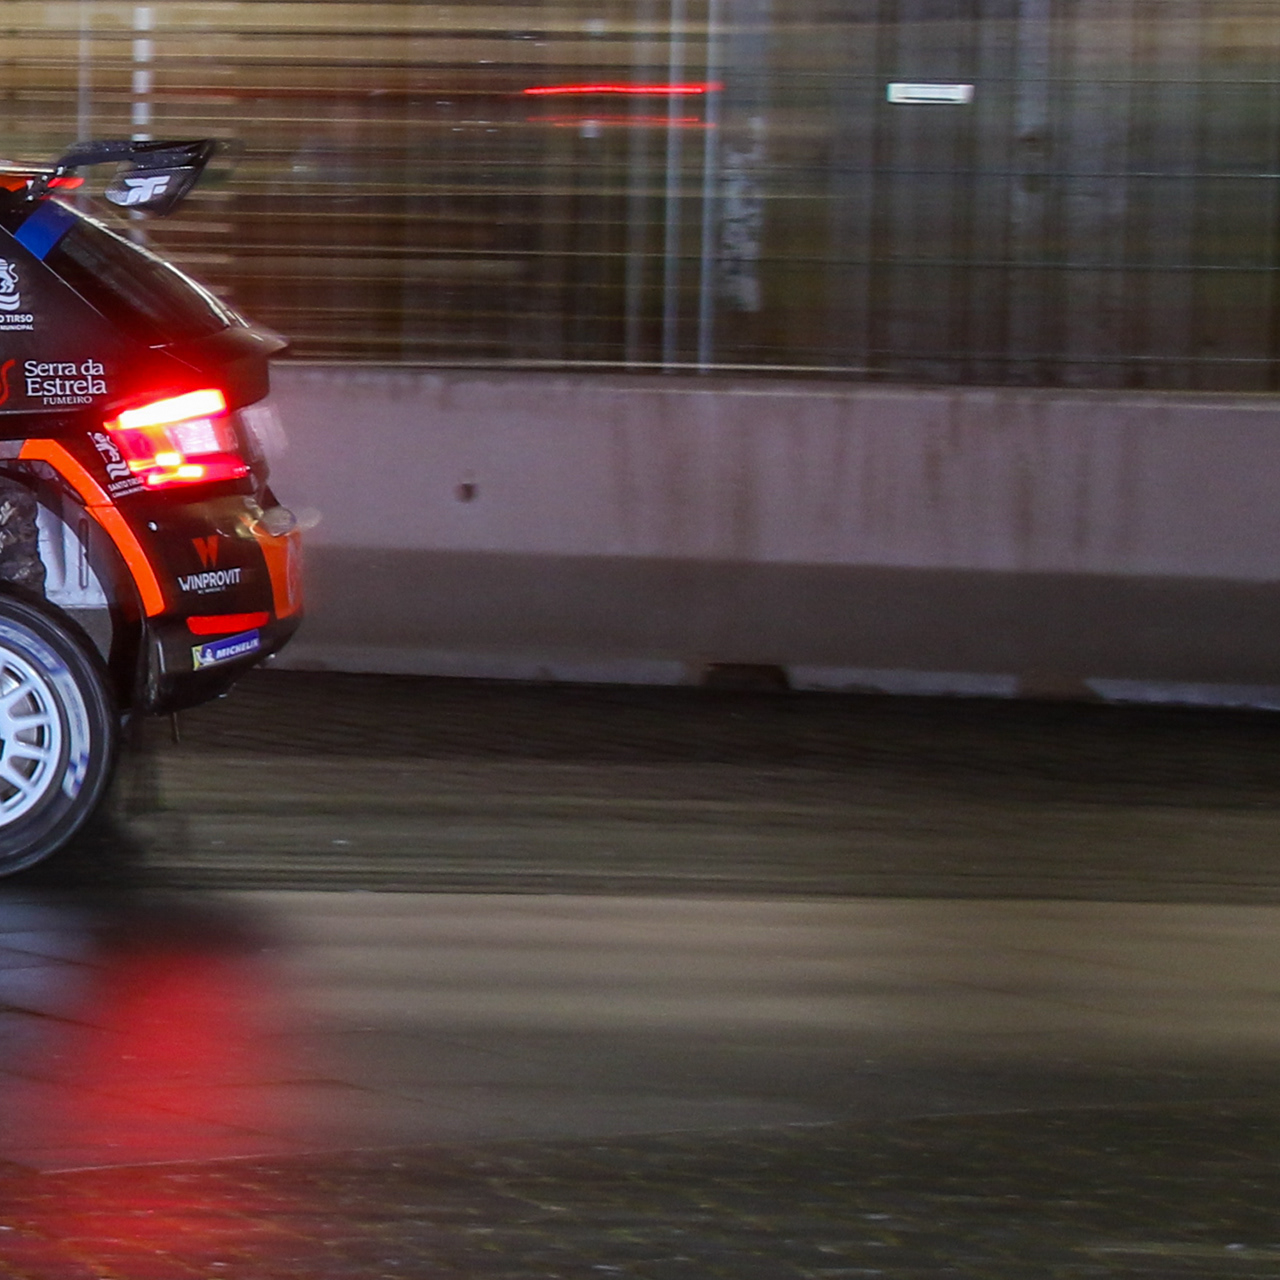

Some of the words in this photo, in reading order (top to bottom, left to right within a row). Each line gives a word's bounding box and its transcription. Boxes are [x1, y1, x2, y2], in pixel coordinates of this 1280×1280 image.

[5, 314, 33, 323] TIRSO
[24, 361, 77, 376] Serra
[81, 359, 104, 376] da
[26, 376, 107, 396] Estrela
[43, 396, 93, 405] FUMEIRO
[178, 568, 241, 591] WINPROVIT
[216, 637, 259, 659] MICHELIN
